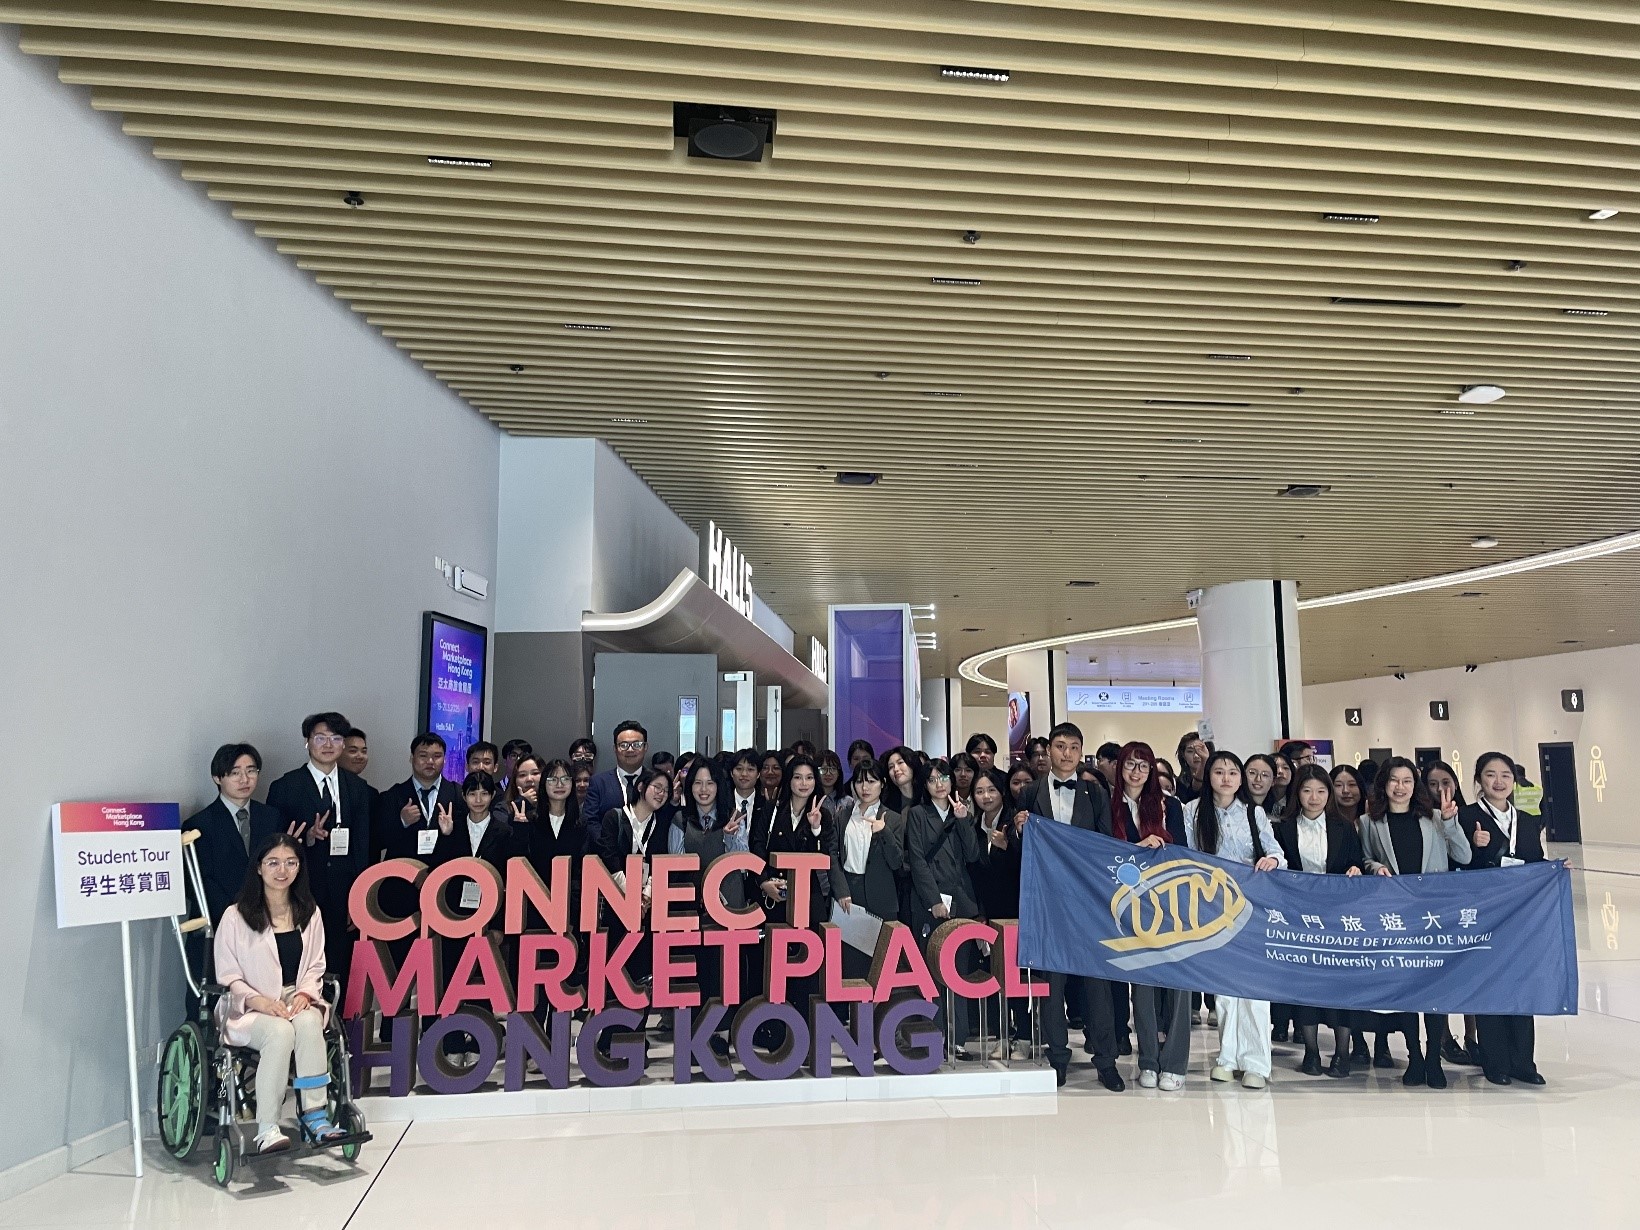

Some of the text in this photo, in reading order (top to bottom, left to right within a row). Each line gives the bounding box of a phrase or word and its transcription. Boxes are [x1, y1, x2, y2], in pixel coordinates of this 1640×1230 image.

[440, 639, 460, 653] Connect
[442, 650, 472, 666] Marketplace
[447, 663, 473, 680] Hong Kong
[106, 813, 143, 821] Marketplace
[78, 848, 170, 866] Student Tour
[80, 870, 171, 897] 學生導賞團
[348, 852, 831, 941] CONNECT
[1264, 907, 1478, 932] 澳門旅遊大學
[1266, 928, 1492, 947] UNIVERSIDADE DE TURISMO DE MACAU
[1266, 948, 1444, 971] Macao University of Tourism
[347, 998, 945, 1099] HONG KONG
